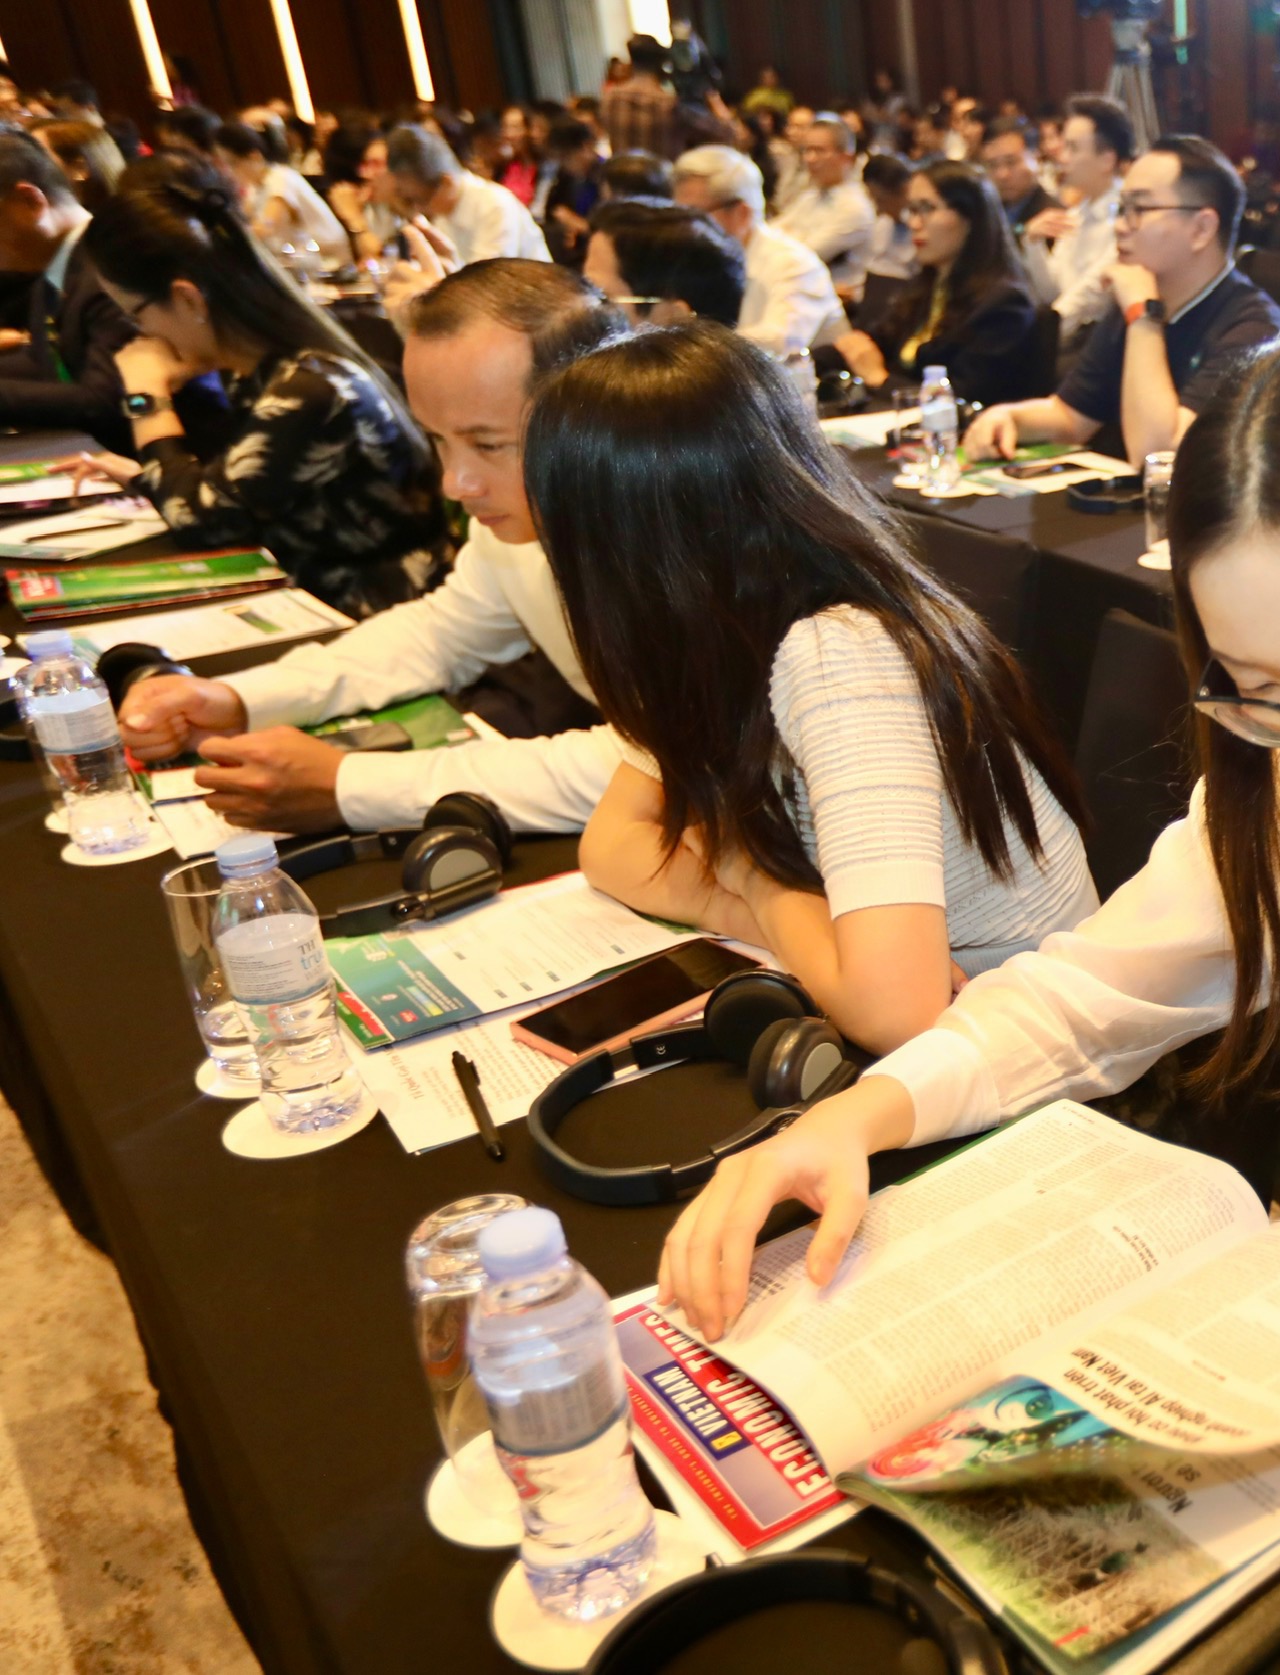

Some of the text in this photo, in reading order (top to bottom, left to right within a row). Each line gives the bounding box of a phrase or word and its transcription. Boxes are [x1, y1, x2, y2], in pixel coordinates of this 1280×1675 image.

[298, 940, 316, 955] TH
[650, 1362, 730, 1440] VIETNAM
[705, 1369, 829, 1494] ECONOMIC
